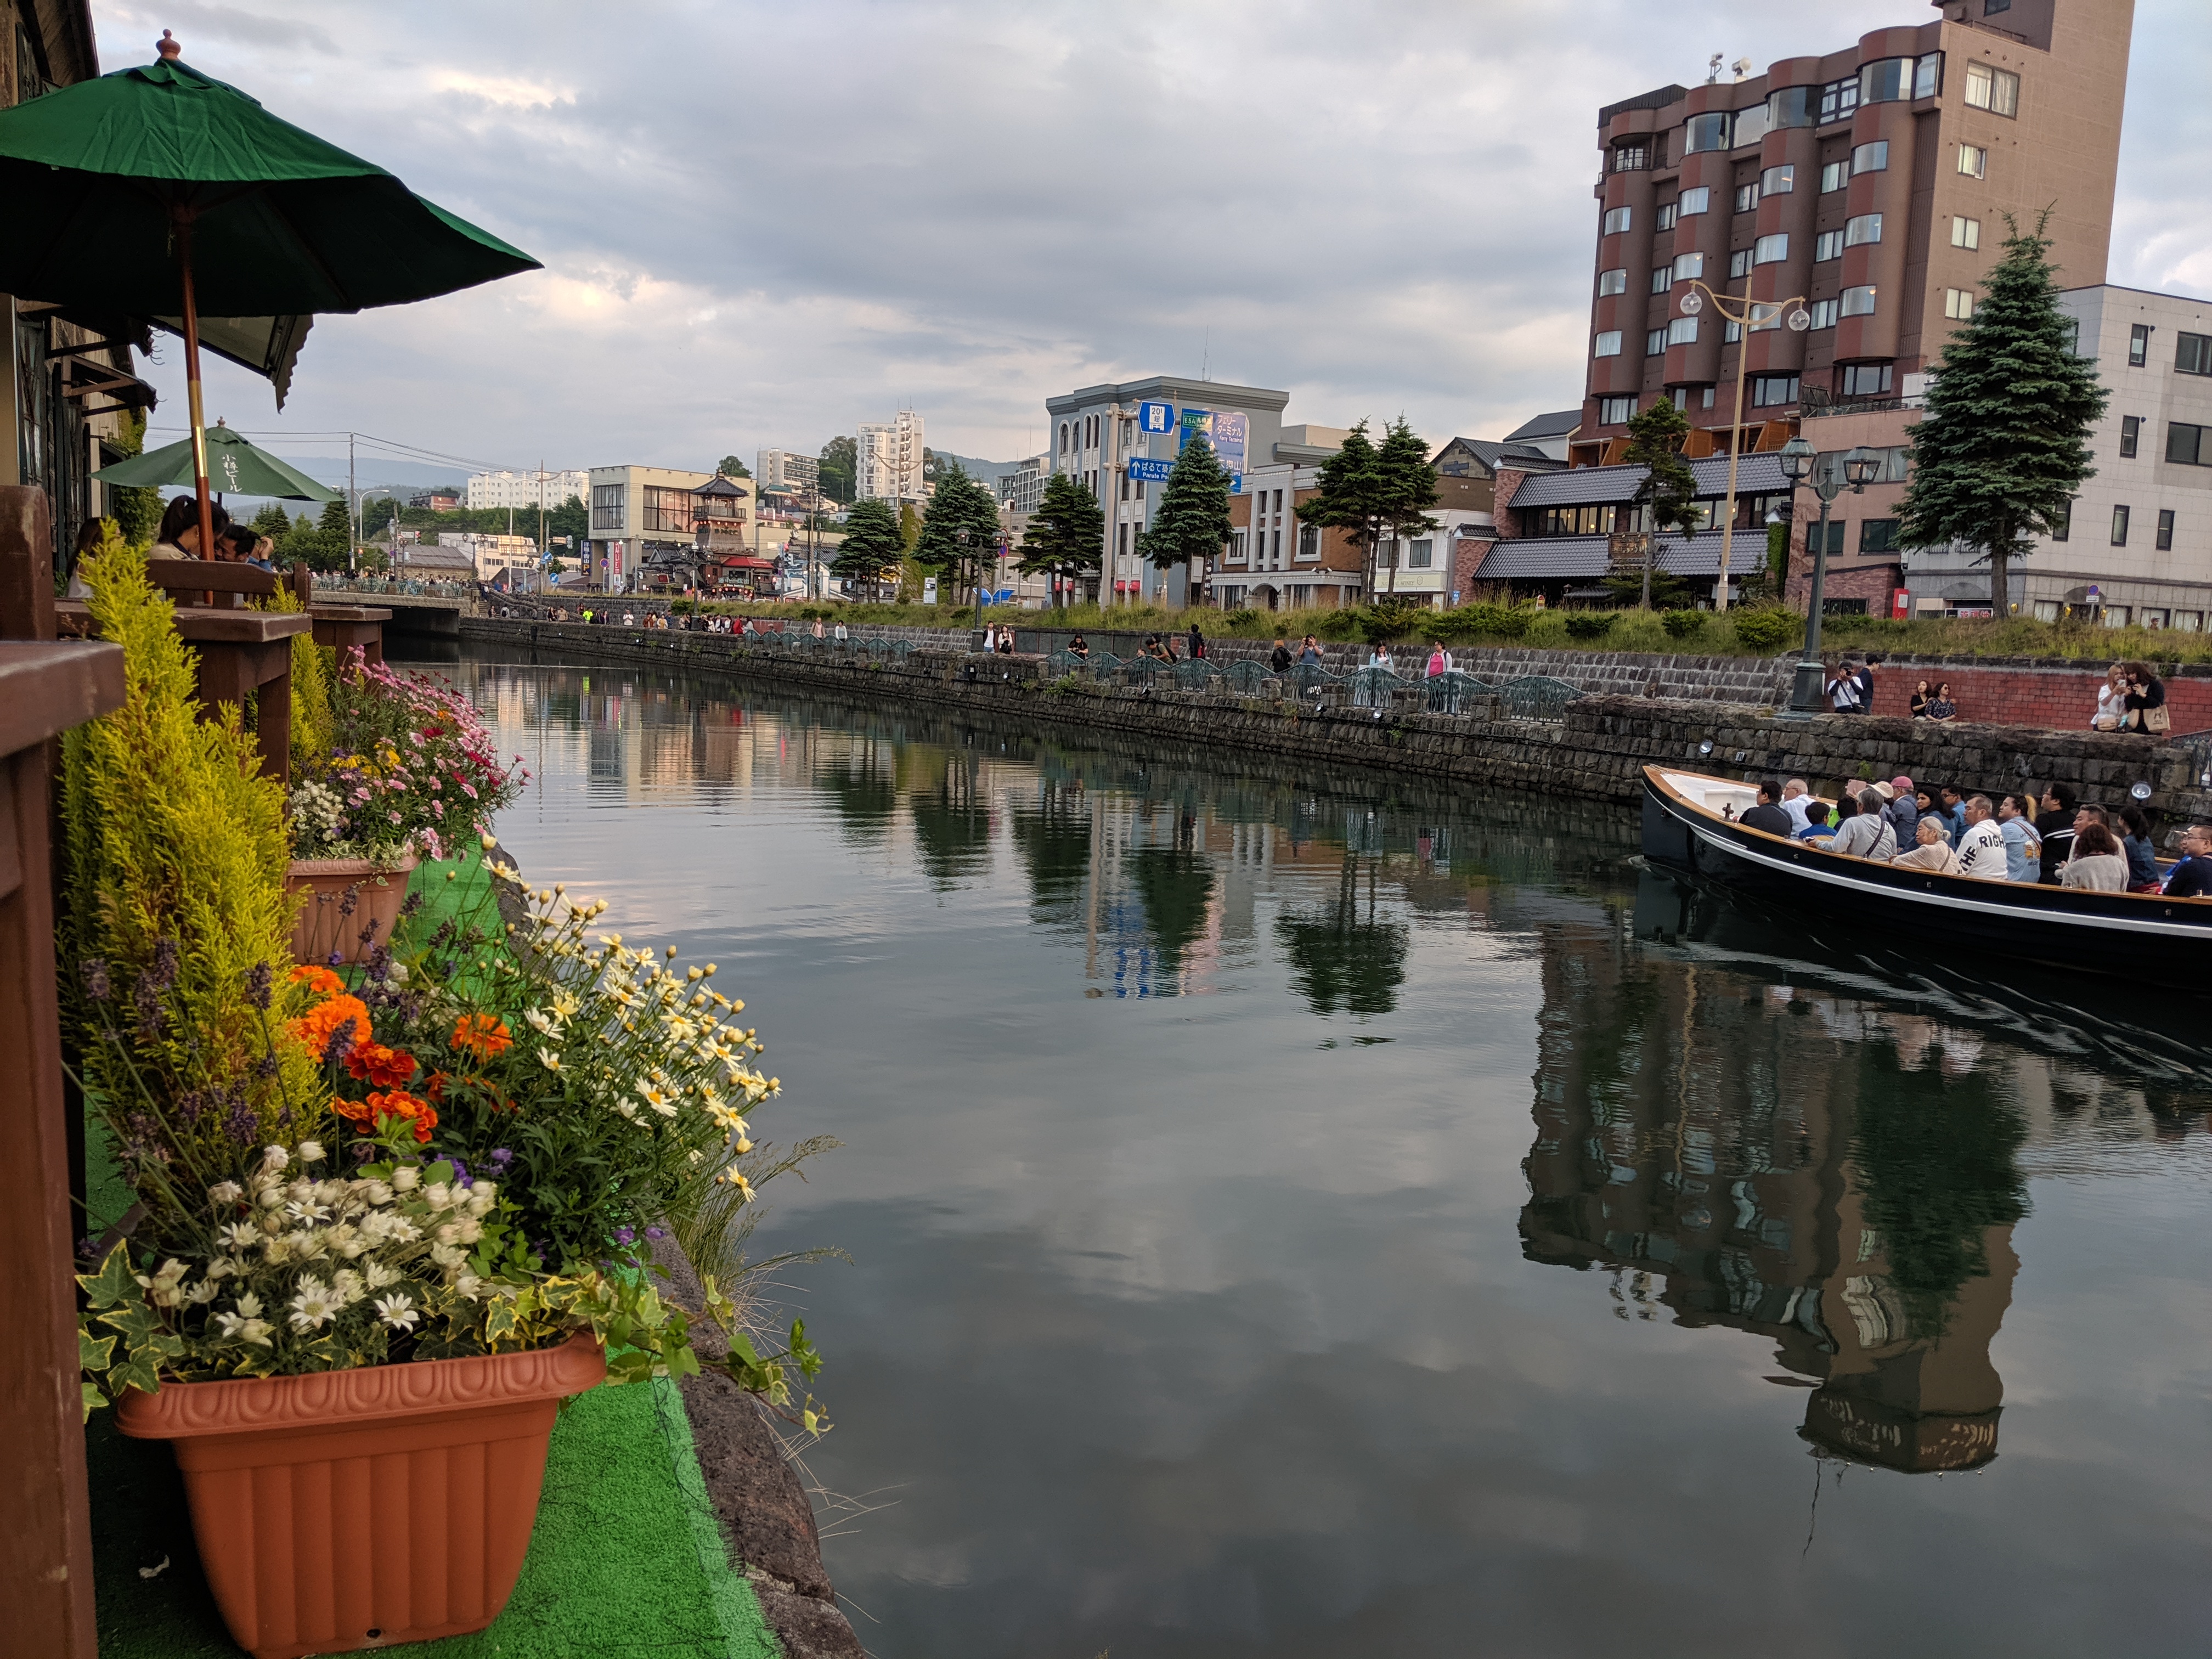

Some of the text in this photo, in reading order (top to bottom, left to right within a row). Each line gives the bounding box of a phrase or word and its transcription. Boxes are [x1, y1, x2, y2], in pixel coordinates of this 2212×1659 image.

[1217, 415, 1235, 426] フェリー
[1217, 426, 1243, 437] ターミナル
[222, 454, 243, 493] 小樽ビール
